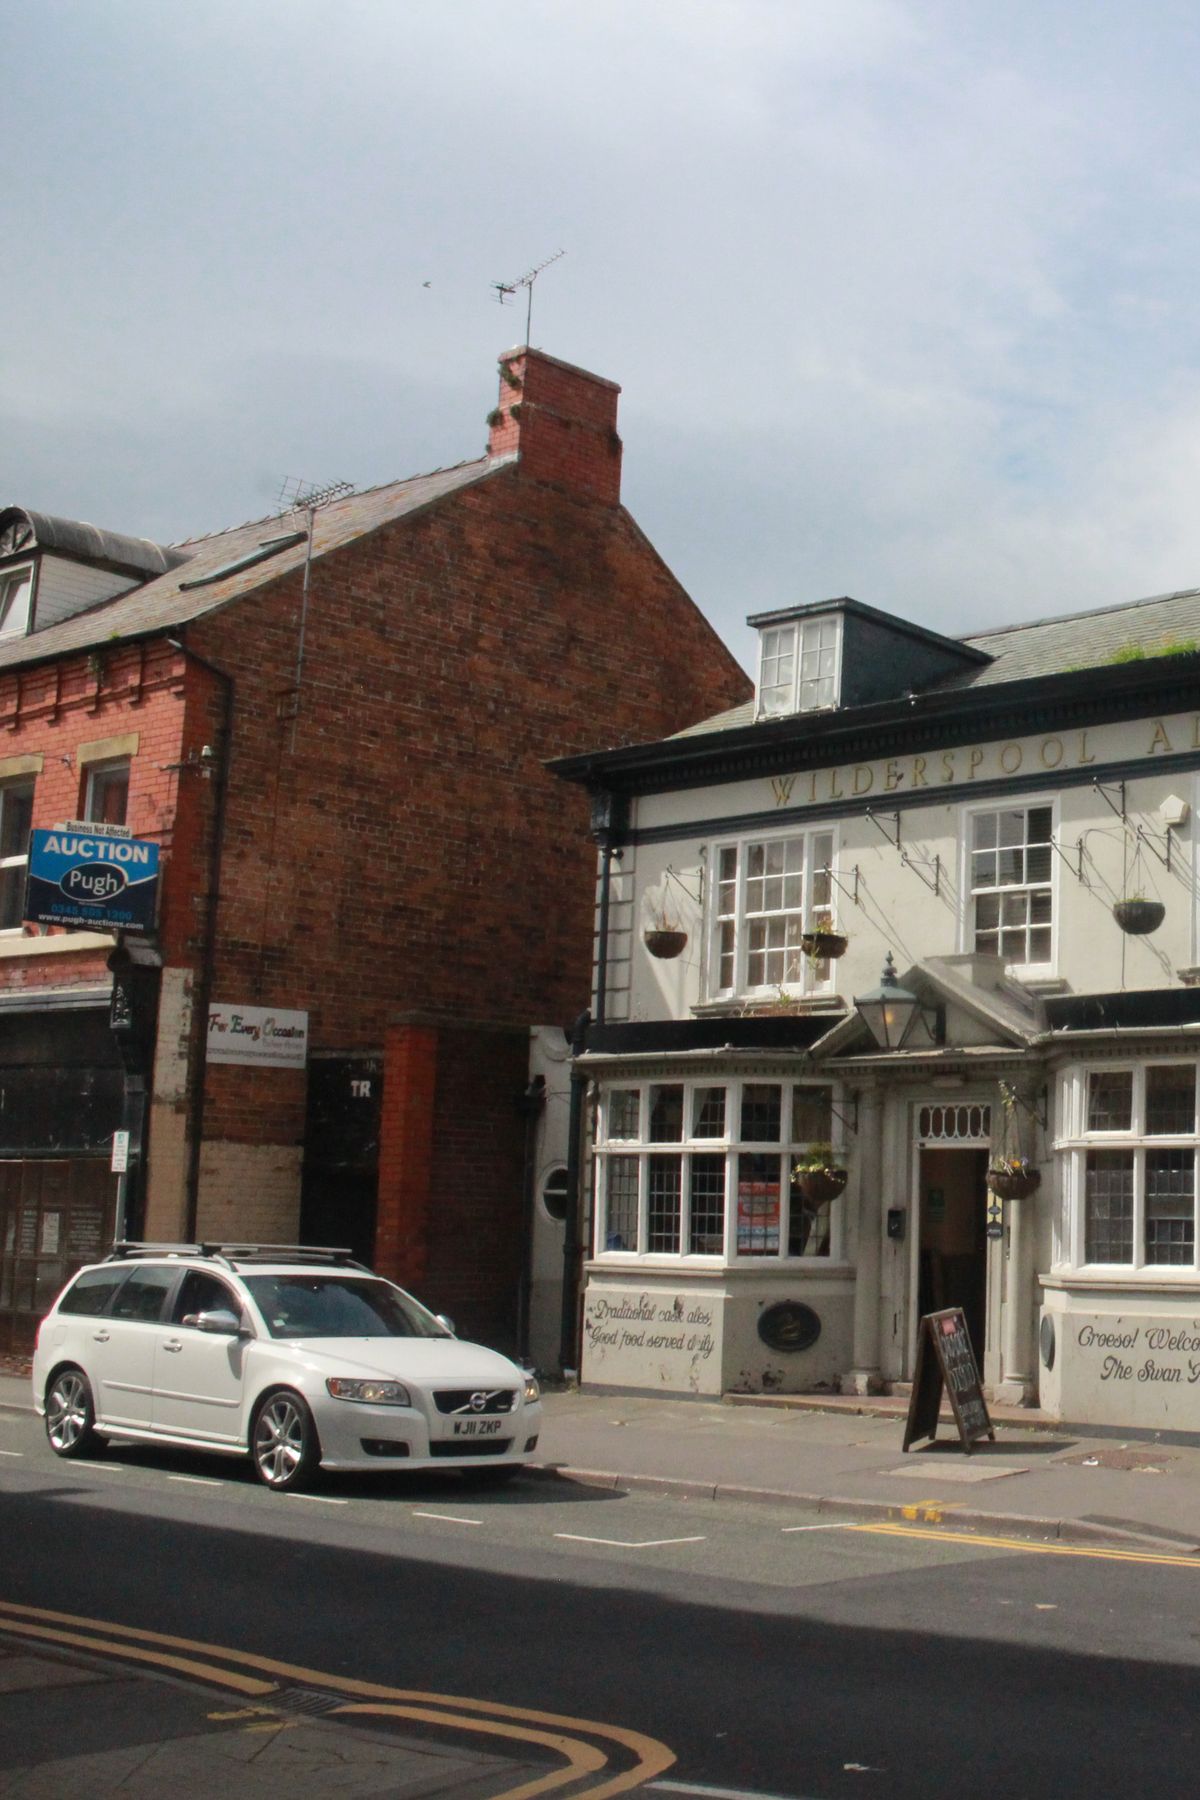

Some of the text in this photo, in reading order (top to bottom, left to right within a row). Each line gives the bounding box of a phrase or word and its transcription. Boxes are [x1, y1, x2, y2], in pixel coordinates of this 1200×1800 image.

[770, 731, 1095, 807] WILDERSPOOL
[67, 822, 130, 839] Business Not Affected
[43, 835, 149, 864] AUCTION
[69, 870, 118, 896] Pugh
[38, 913, 145, 930] www.pugh-auctions.com
[209, 1013, 305, 1041] For Every Occasion
[350, 1080, 371, 1097] TR
[594, 1298, 657, 1321] Traditional
[589, 1325, 714, 1359] Good food served dily
[1077, 1325, 1140, 1349] Croeso!
[1100, 1354, 1133, 1380] The
[1137, 1358, 1182, 1383] Swan
